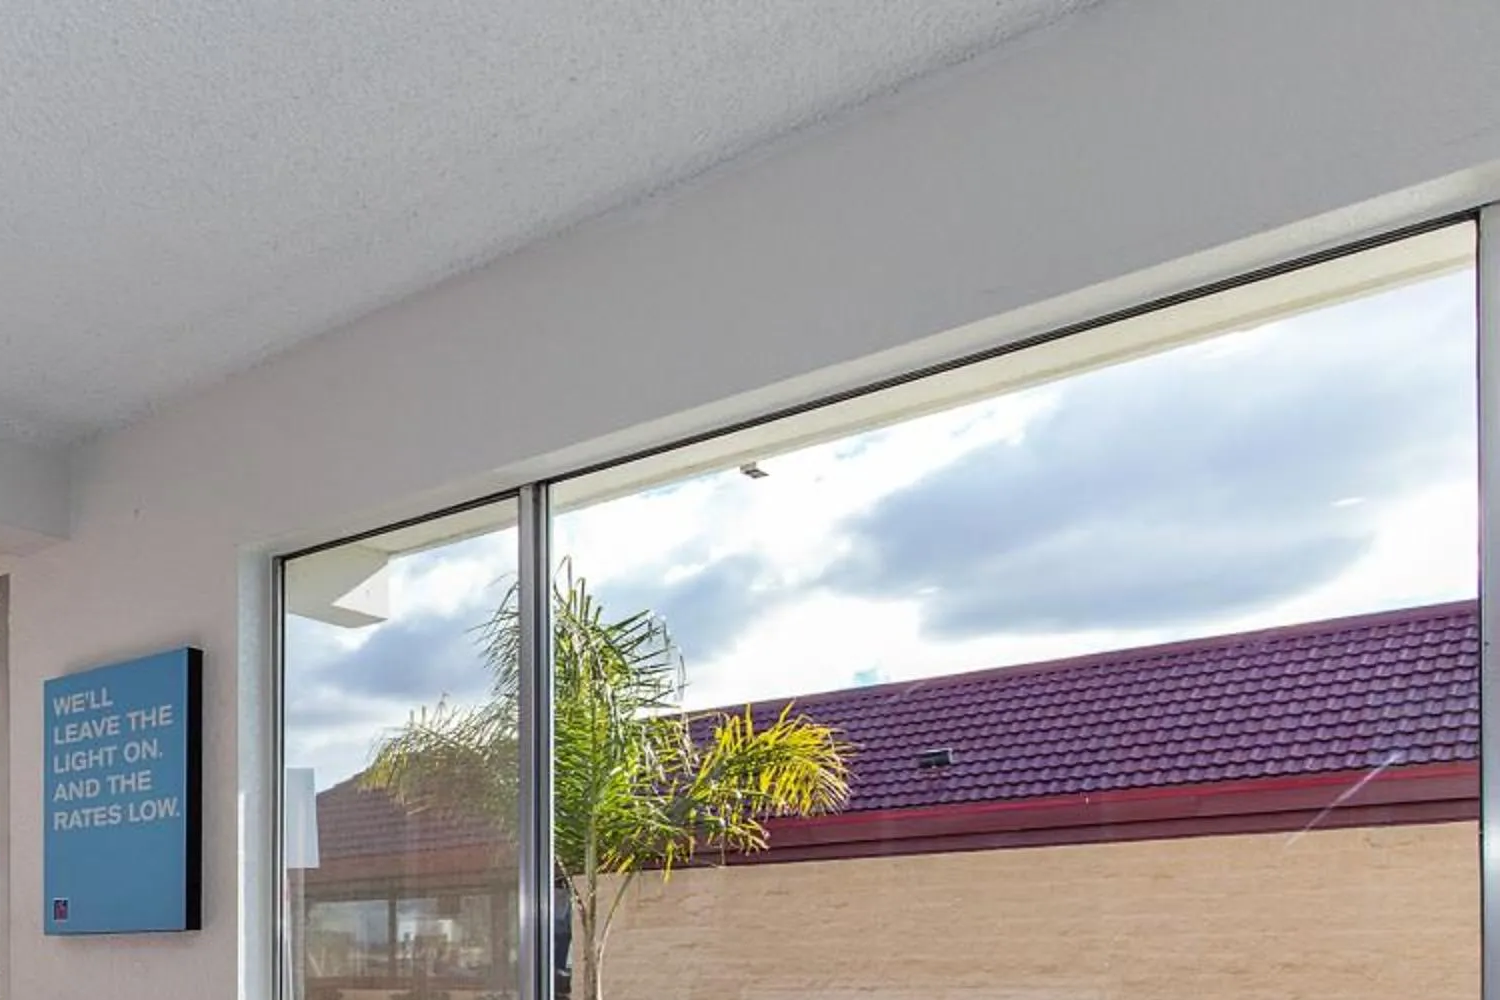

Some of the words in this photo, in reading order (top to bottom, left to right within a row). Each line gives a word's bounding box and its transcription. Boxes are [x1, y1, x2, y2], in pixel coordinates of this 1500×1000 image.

[53, 687, 114, 716] WE'LL
[53, 715, 120, 745] LEAVE
[126, 704, 174, 731] THE
[53, 746, 118, 774] LIGHT
[53, 778, 100, 802] AND
[107, 769, 152, 795] THE
[53, 804, 122, 831] RATES
[129, 796, 181, 823] LOW.
